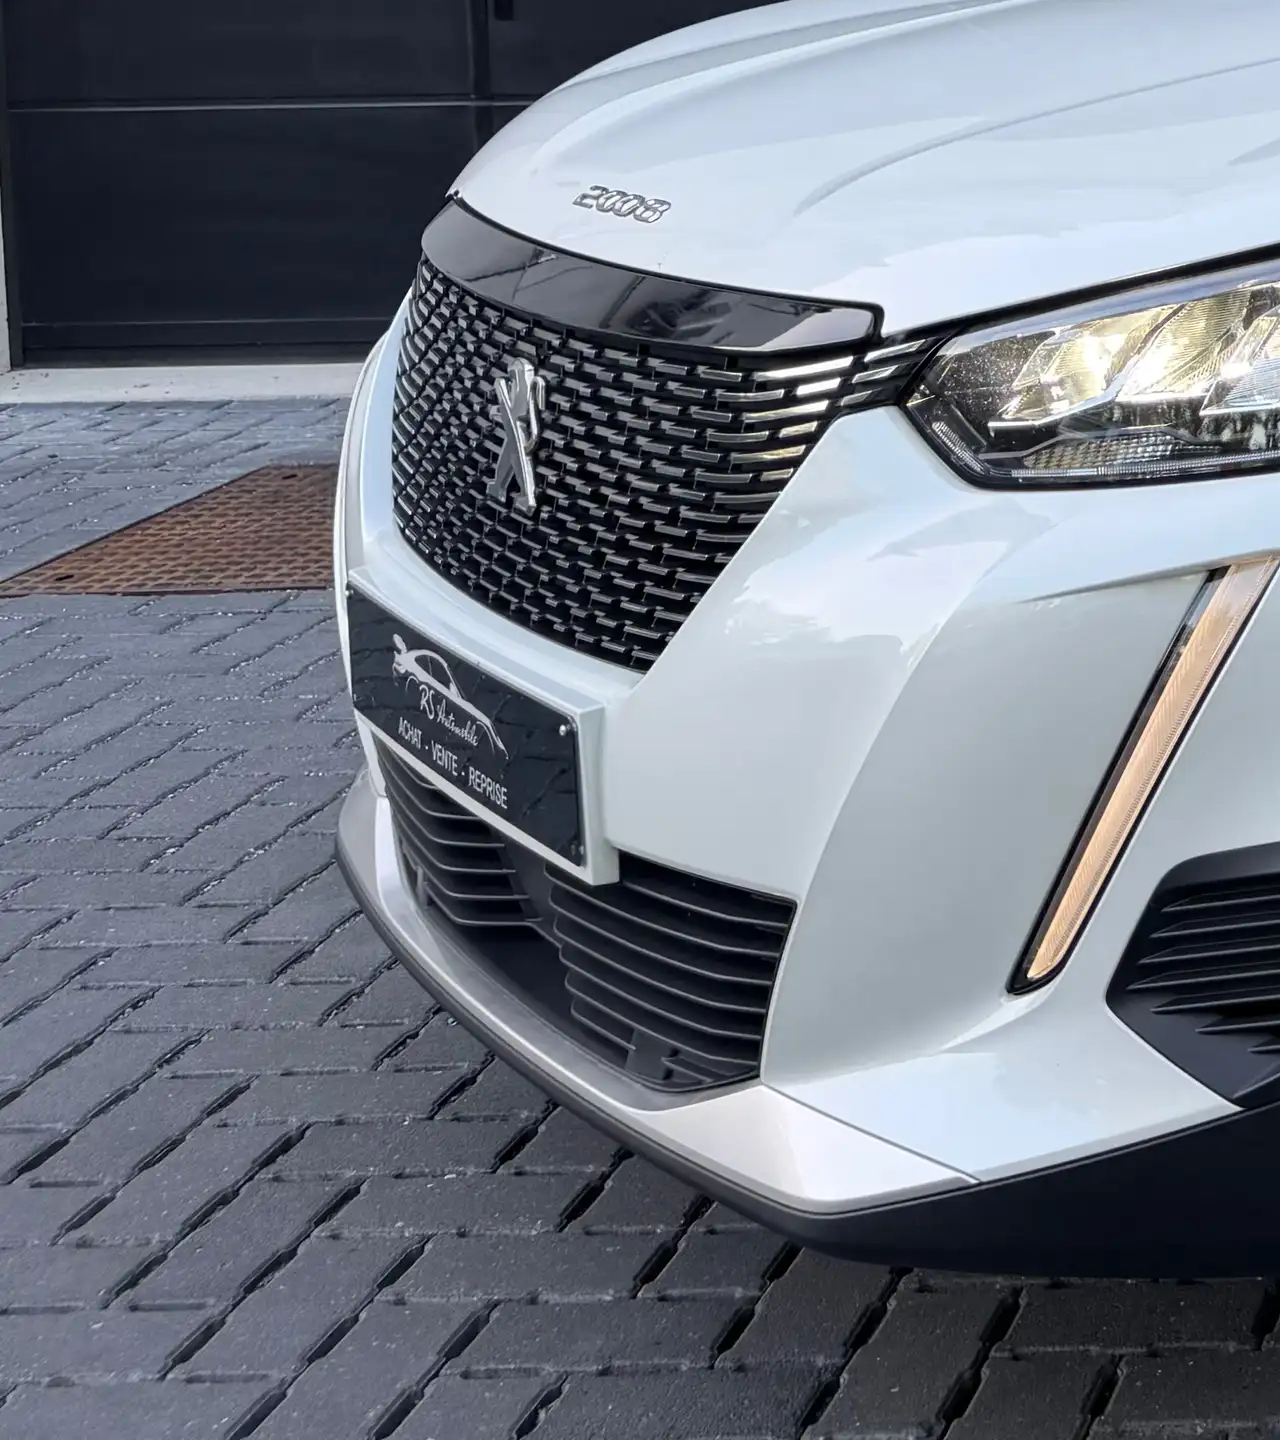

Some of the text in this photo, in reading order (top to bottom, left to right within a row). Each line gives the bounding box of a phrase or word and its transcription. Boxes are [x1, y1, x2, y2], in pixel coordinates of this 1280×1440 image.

[572, 185, 671, 223] 2008
[419, 684, 435, 720] RS
[398, 716, 422, 749] ACHAT
[431, 739, 458, 776] VENTE
[468, 766, 508, 809] REPRISE
